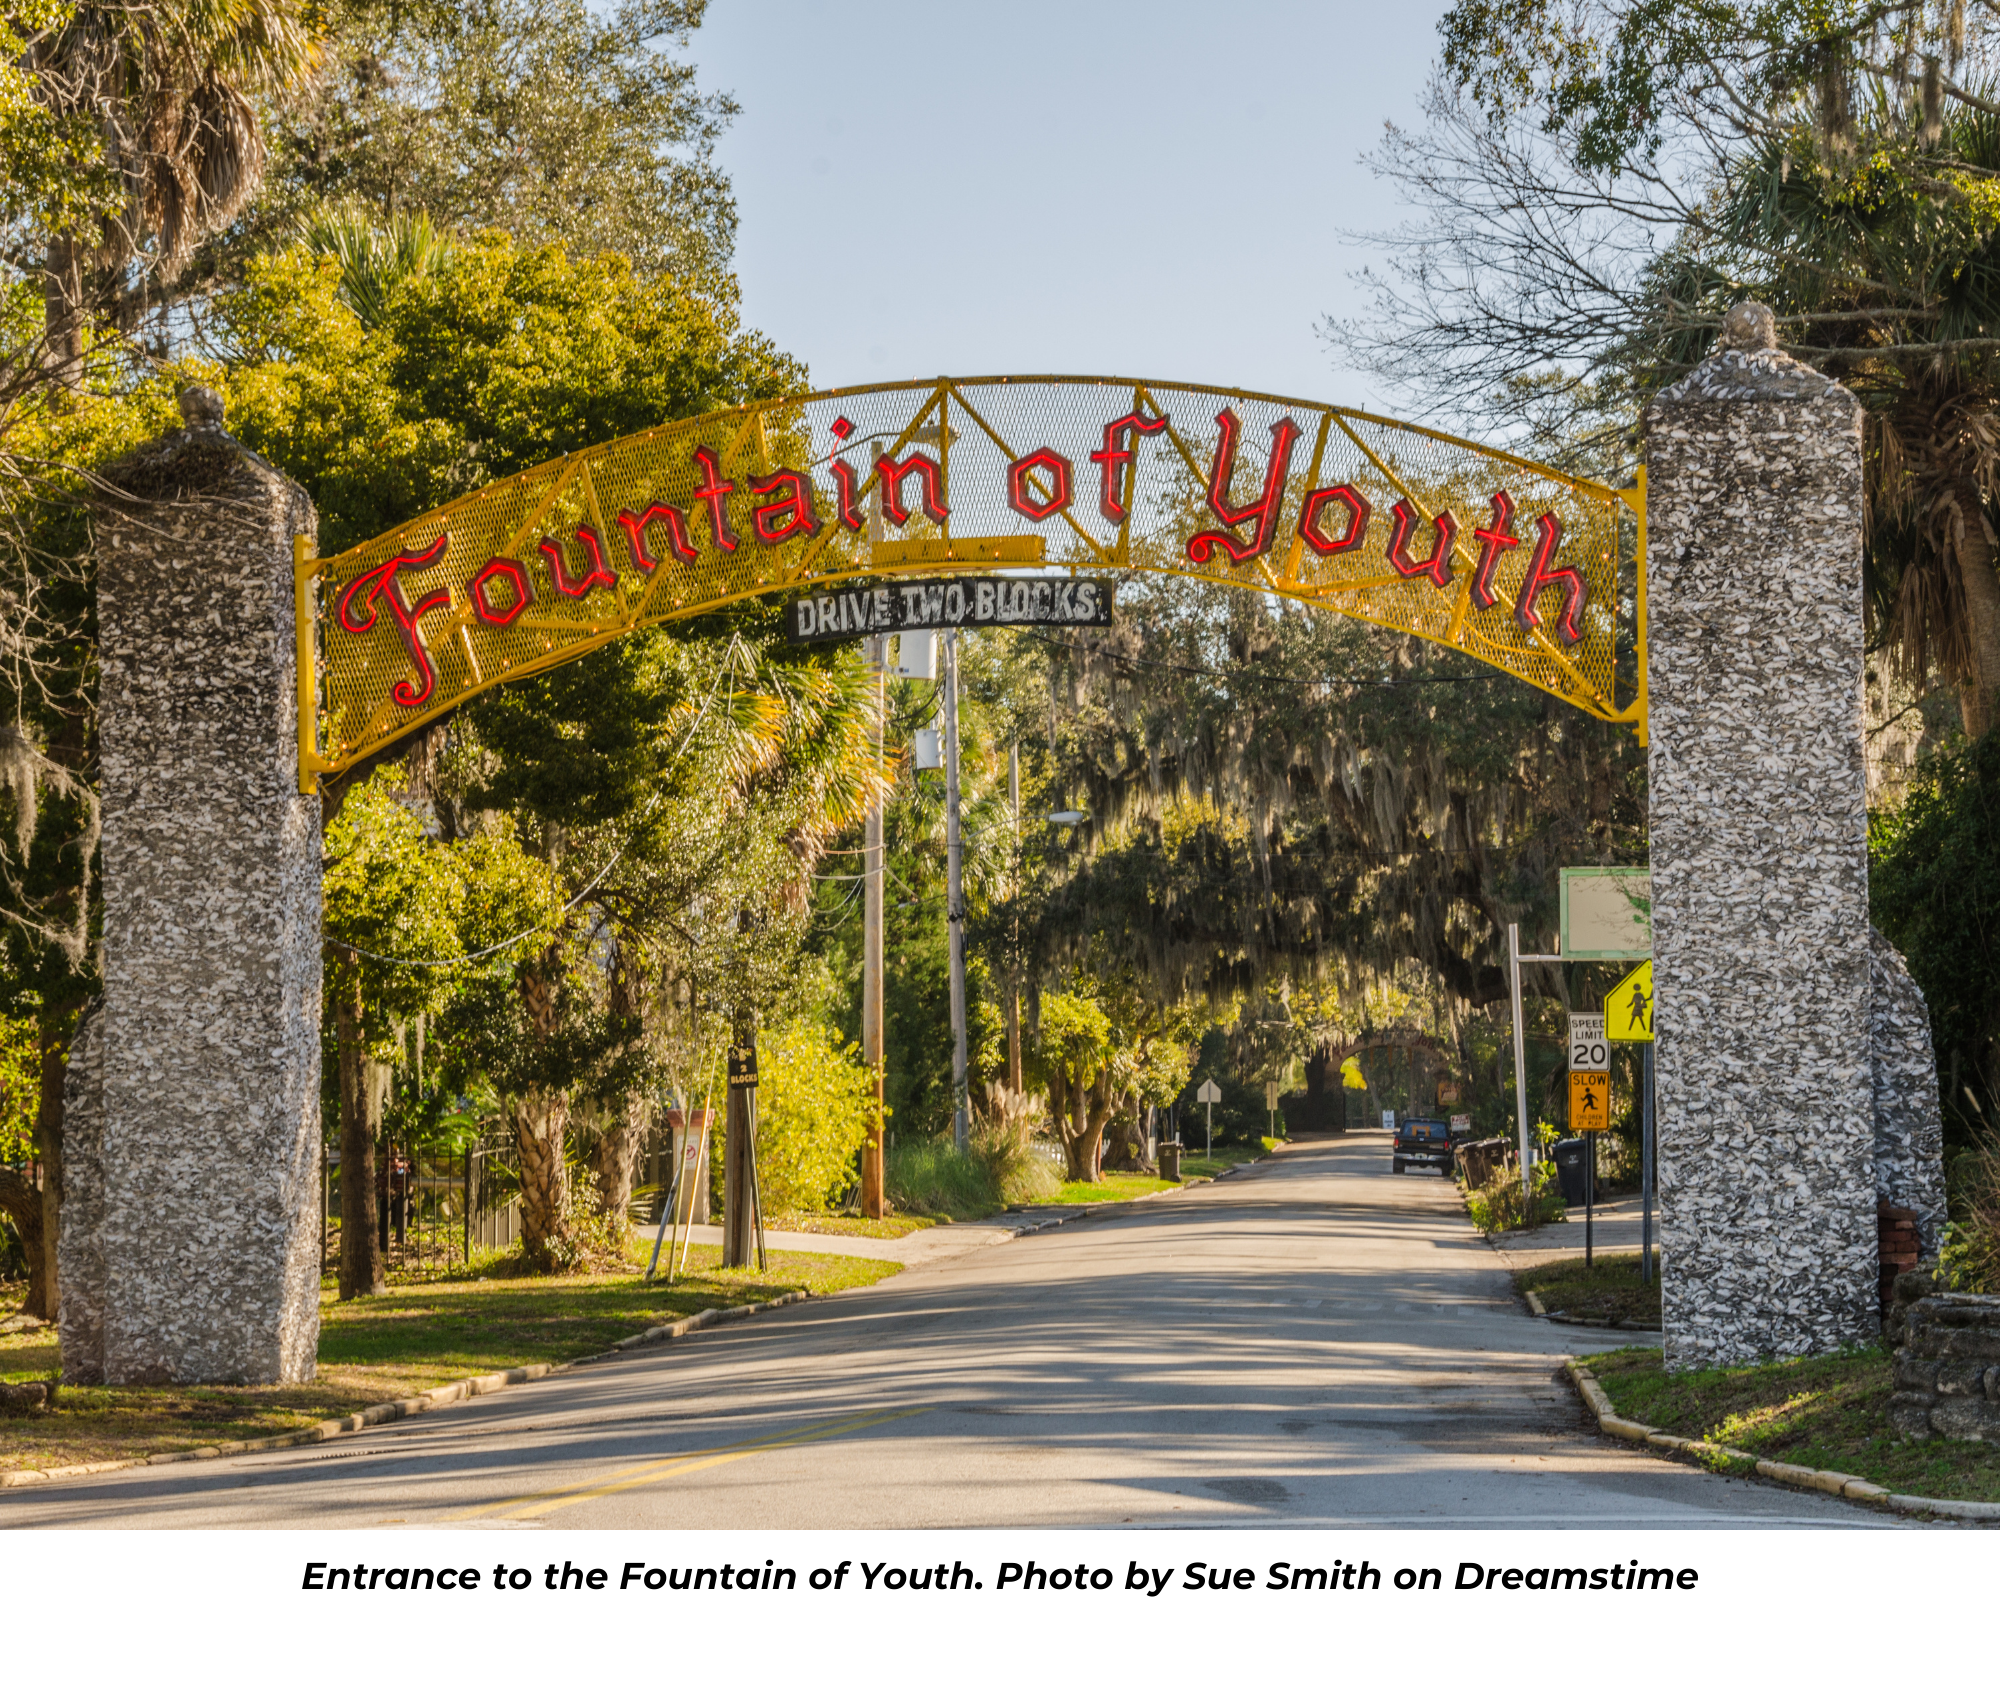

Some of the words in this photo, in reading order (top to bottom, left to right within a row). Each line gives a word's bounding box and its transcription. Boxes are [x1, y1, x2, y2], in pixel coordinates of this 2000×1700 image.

[335, 415, 948, 708] Fountain
[1007, 409, 1170, 526] of
[1186, 406, 1588, 646] Youth
[797, 588, 891, 637] DRIVE
[901, 583, 966, 624] TWO
[974, 581, 1097, 622] BLOCKS
[1571, 1019, 1605, 1028] SPEED
[1575, 1031, 1603, 1039] LIMIT
[1573, 1044, 1606, 1064] 20
[740, 1064, 748, 1073] 2
[730, 1073, 758, 1084] BLOCKS
[1573, 1075, 1606, 1085] SLOW
